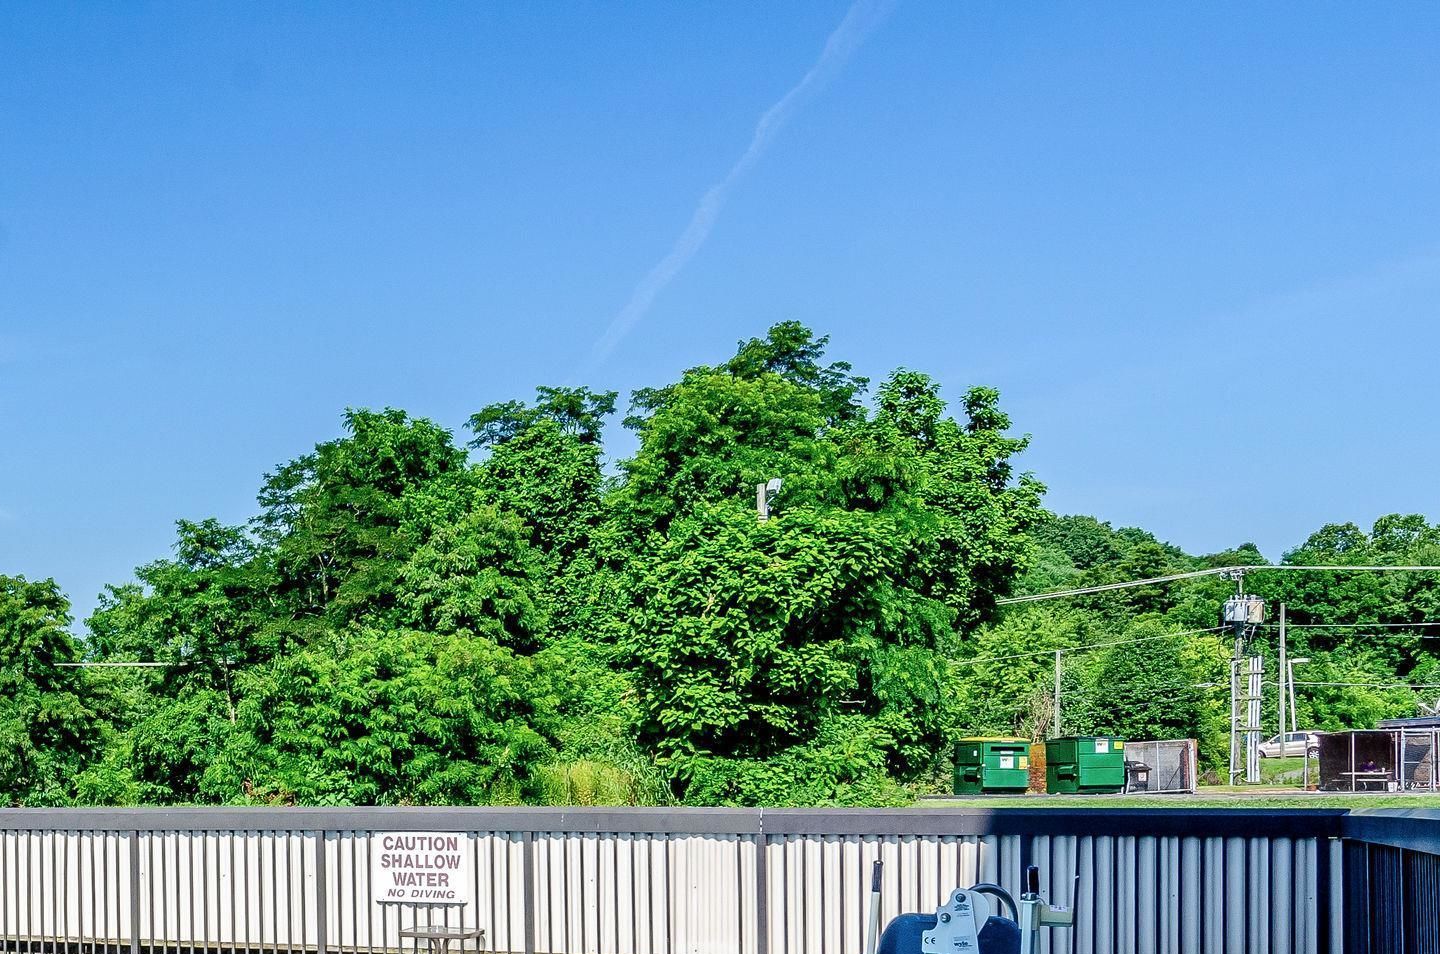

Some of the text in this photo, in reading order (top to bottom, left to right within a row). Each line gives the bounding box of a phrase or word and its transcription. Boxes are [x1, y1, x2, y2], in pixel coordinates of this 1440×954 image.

[383, 836, 458, 851] CAUTION
[381, 854, 461, 869] SHALLOW
[393, 872, 449, 887] WATER
[387, 889, 455, 899] NO DIVING
